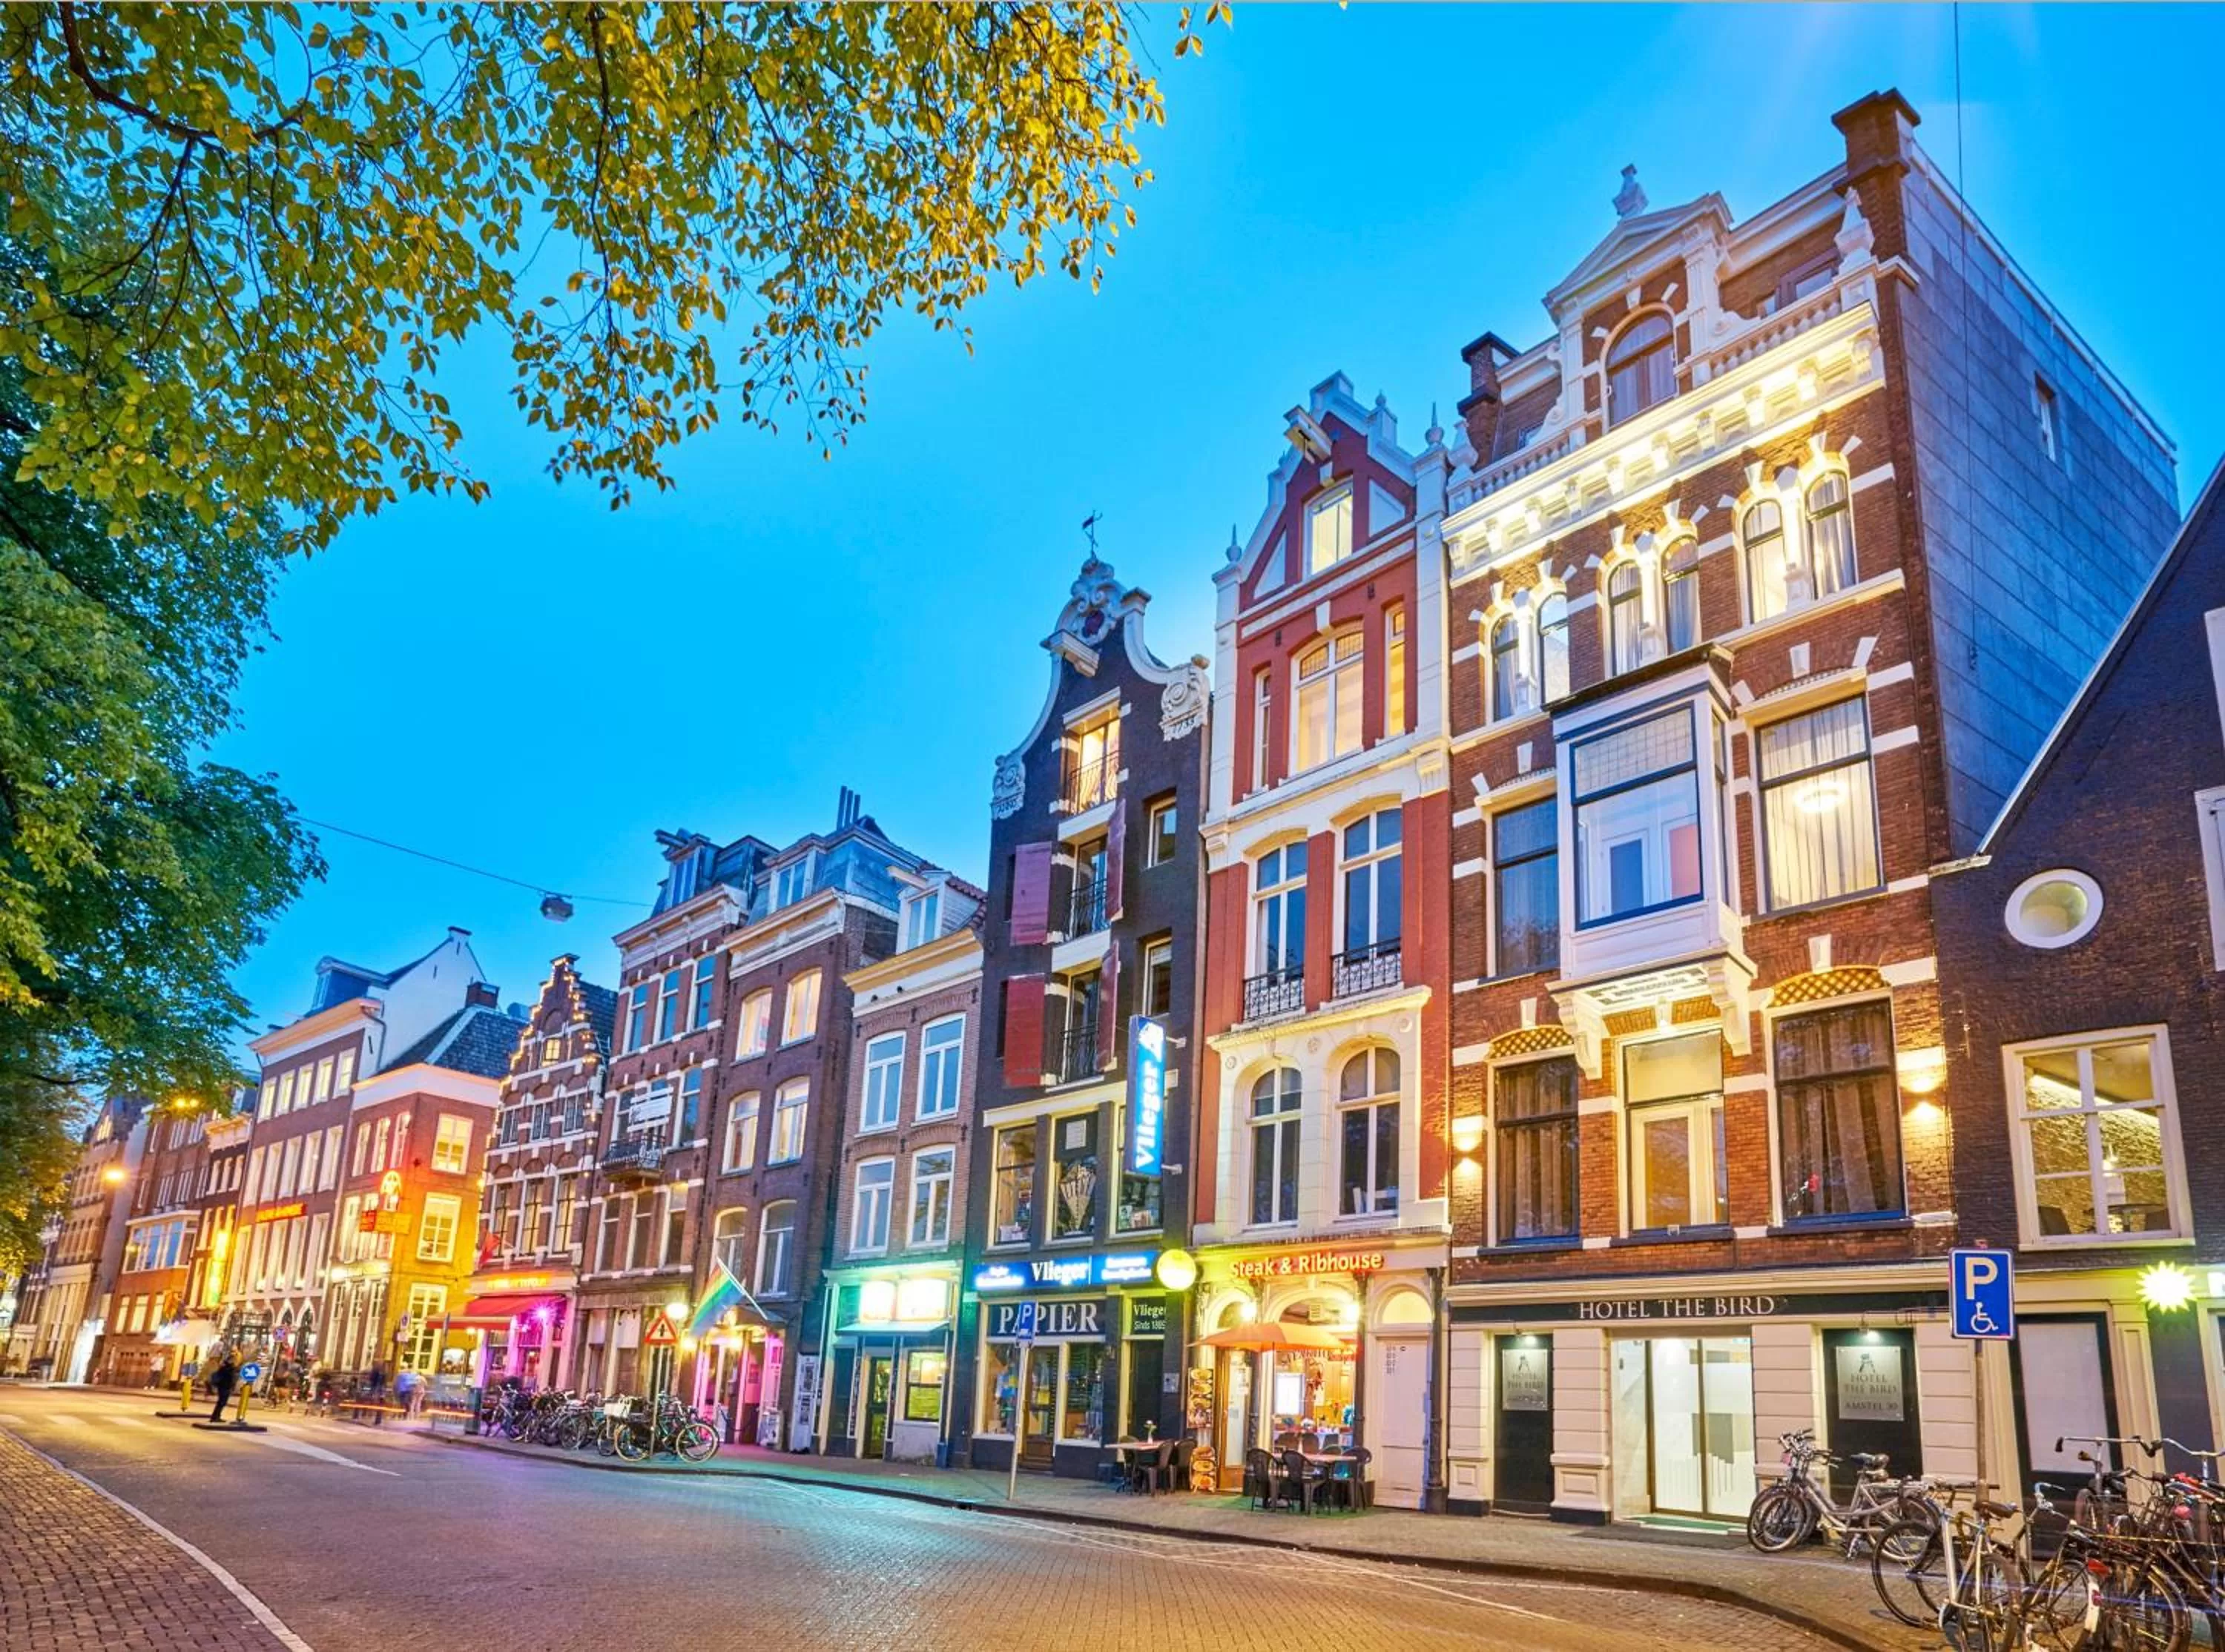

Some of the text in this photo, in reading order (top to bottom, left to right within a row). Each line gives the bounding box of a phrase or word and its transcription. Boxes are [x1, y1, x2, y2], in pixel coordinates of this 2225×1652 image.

[1135, 1060, 1160, 1168] Vlieger
[1032, 1261, 1090, 1286] Vlieger
[1230, 1252, 1382, 1277] Steak & Ribhouse
[1965, 1257, 1998, 1300] P
[998, 1303, 1099, 1334] PPIER
[1021, 1304, 1032, 1324] P
[1579, 1296, 1774, 1319] HOTEL THE BIRD
[1844, 1384, 1897, 1395] THE BIRD
[1850, 1372, 1888, 1383] HOTEL
